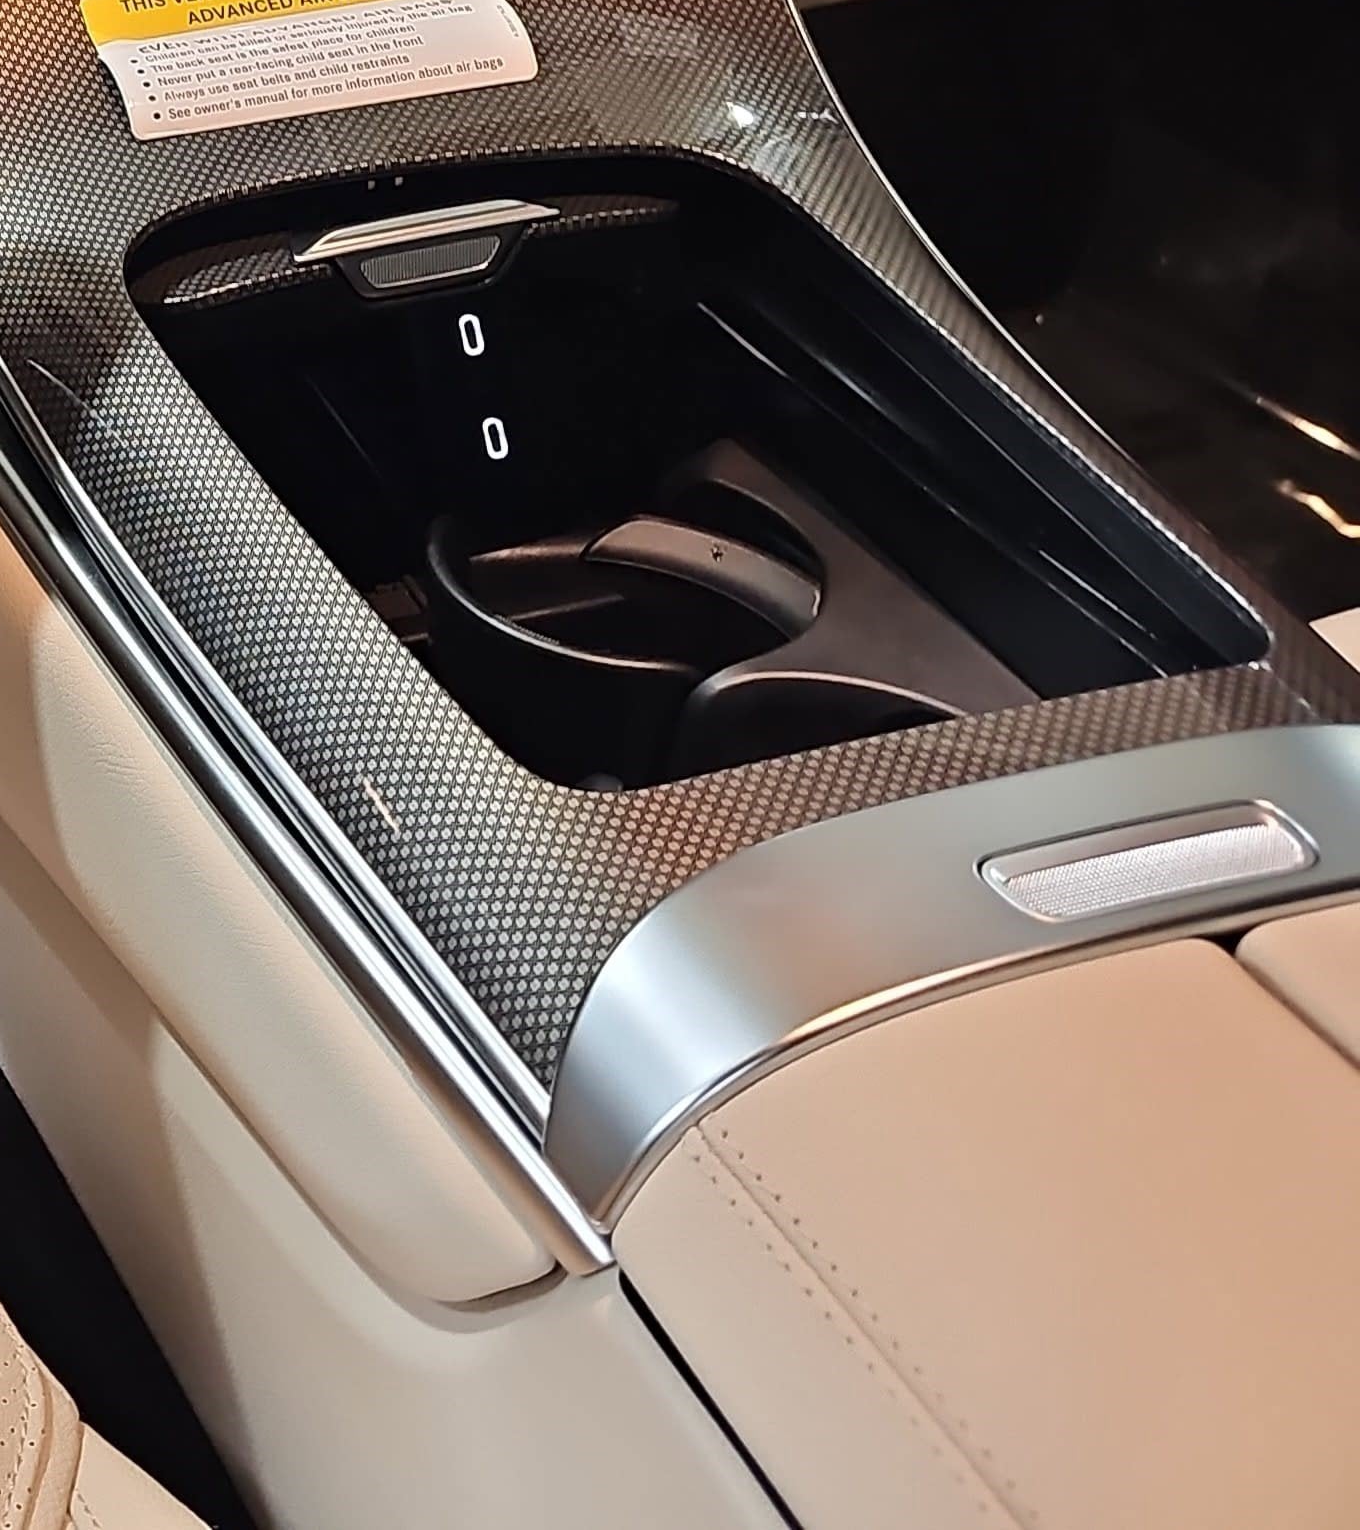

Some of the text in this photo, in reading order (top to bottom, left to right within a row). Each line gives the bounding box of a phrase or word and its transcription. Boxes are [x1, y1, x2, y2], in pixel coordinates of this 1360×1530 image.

[151, 64, 174, 73] The
[176, 59, 205, 70] back
[207, 54, 233, 63] seat
[250, 47, 270, 56] the
[272, 42, 308, 54] safest
[312, 37, 343, 49] place
[346, 33, 363, 42] for
[366, 24, 415, 38] children
[157, 75, 192, 87] Never
[196, 70, 216, 82] put
[229, 58, 294, 76] rear-facing
[296, 51, 325, 65] child
[327, 47, 354, 59] seat
[356, 45, 369, 54] in
[371, 40, 391, 51] the
[393, 36, 424, 49] front
[164, 55, 410, 101] Always use seat belts and child restraints
[168, 57, 504, 120] See owner's manual for more information about air bags
